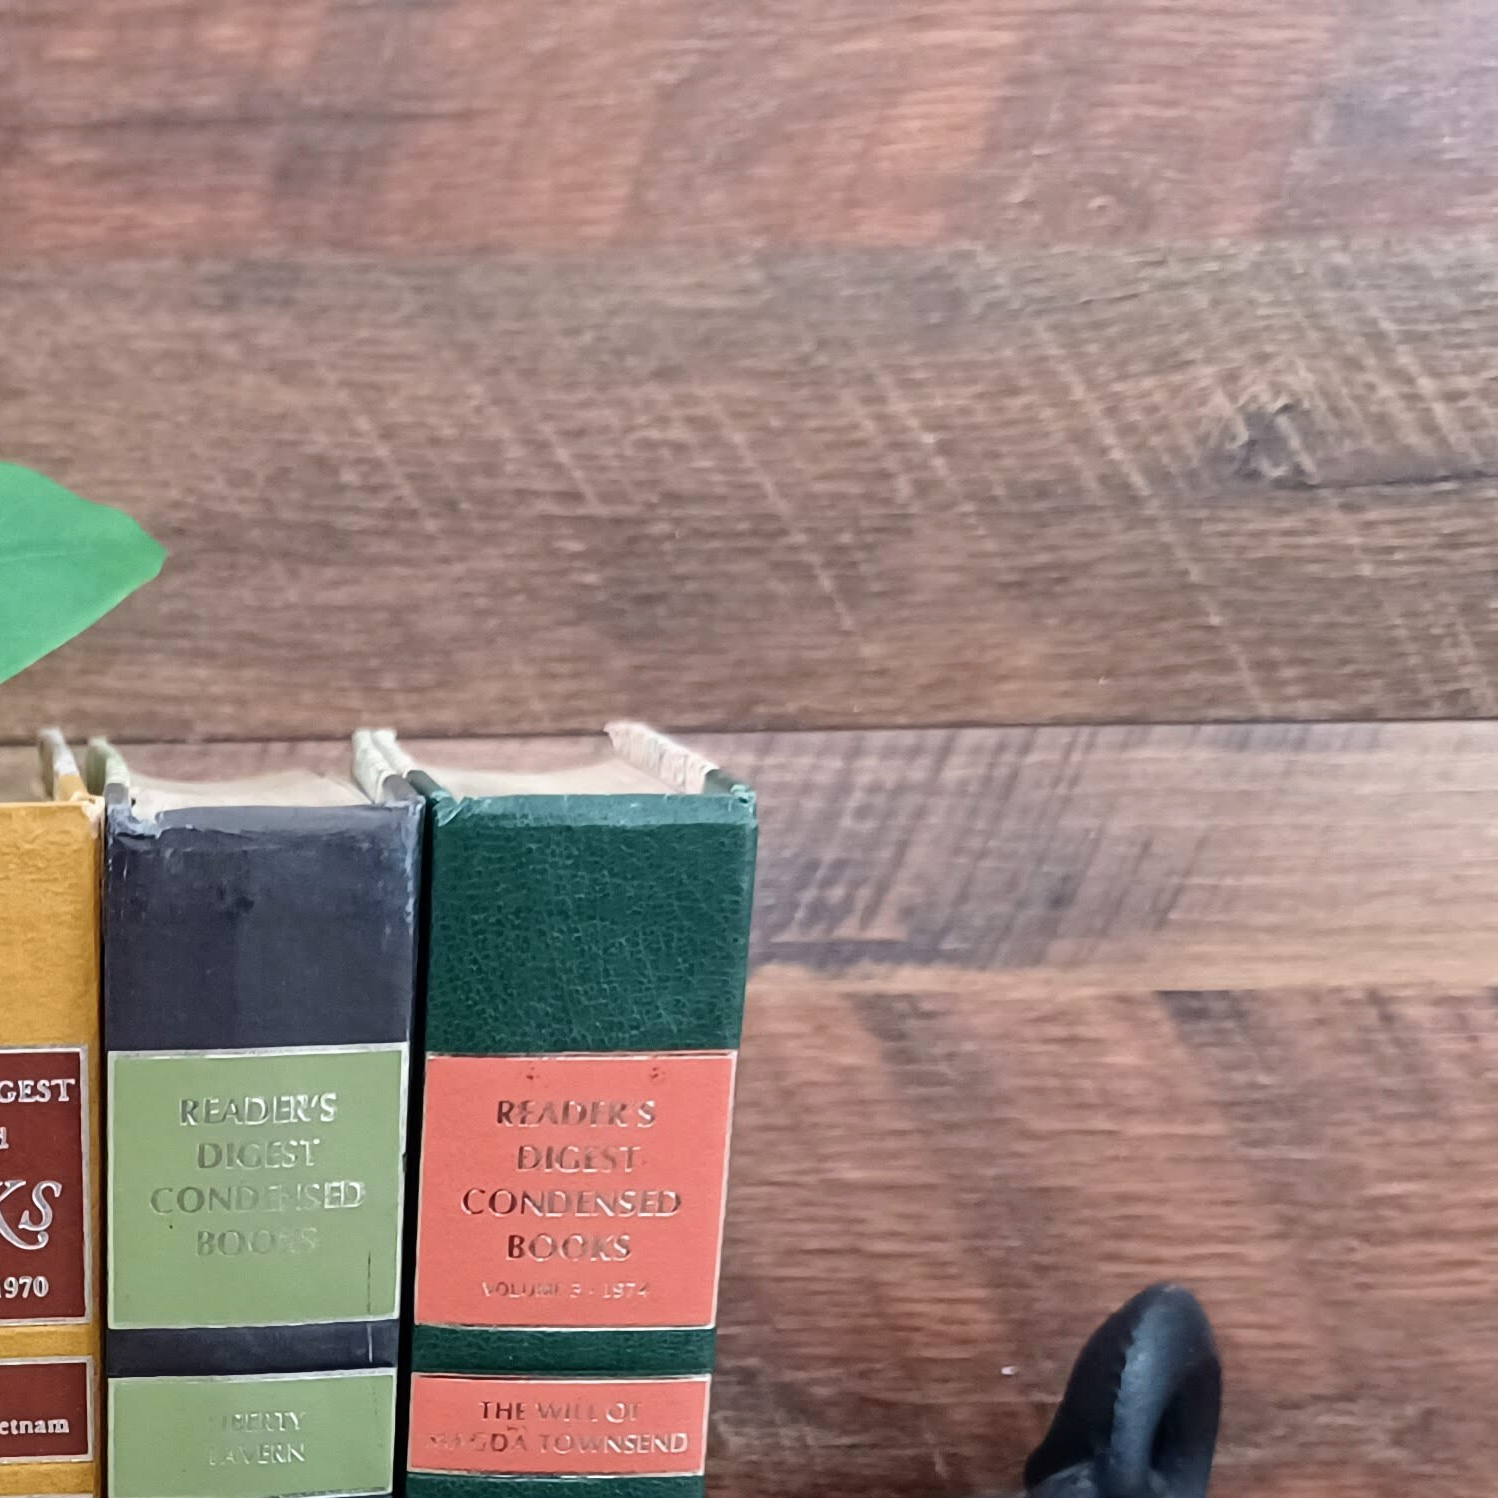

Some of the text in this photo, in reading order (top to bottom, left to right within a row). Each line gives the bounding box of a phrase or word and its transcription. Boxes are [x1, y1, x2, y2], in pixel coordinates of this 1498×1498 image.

[179, 1092, 337, 1127] READER'S
[197, 1137, 321, 1169] DIGEST
[517, 1145, 641, 1173] DIGEST
[461, 1188, 682, 1217] CONDENSED
[506, 1232, 631, 1262] BOOKS
[478, 1400, 526, 1421] THE
[539, 1431, 688, 1454] TOWNSEND
